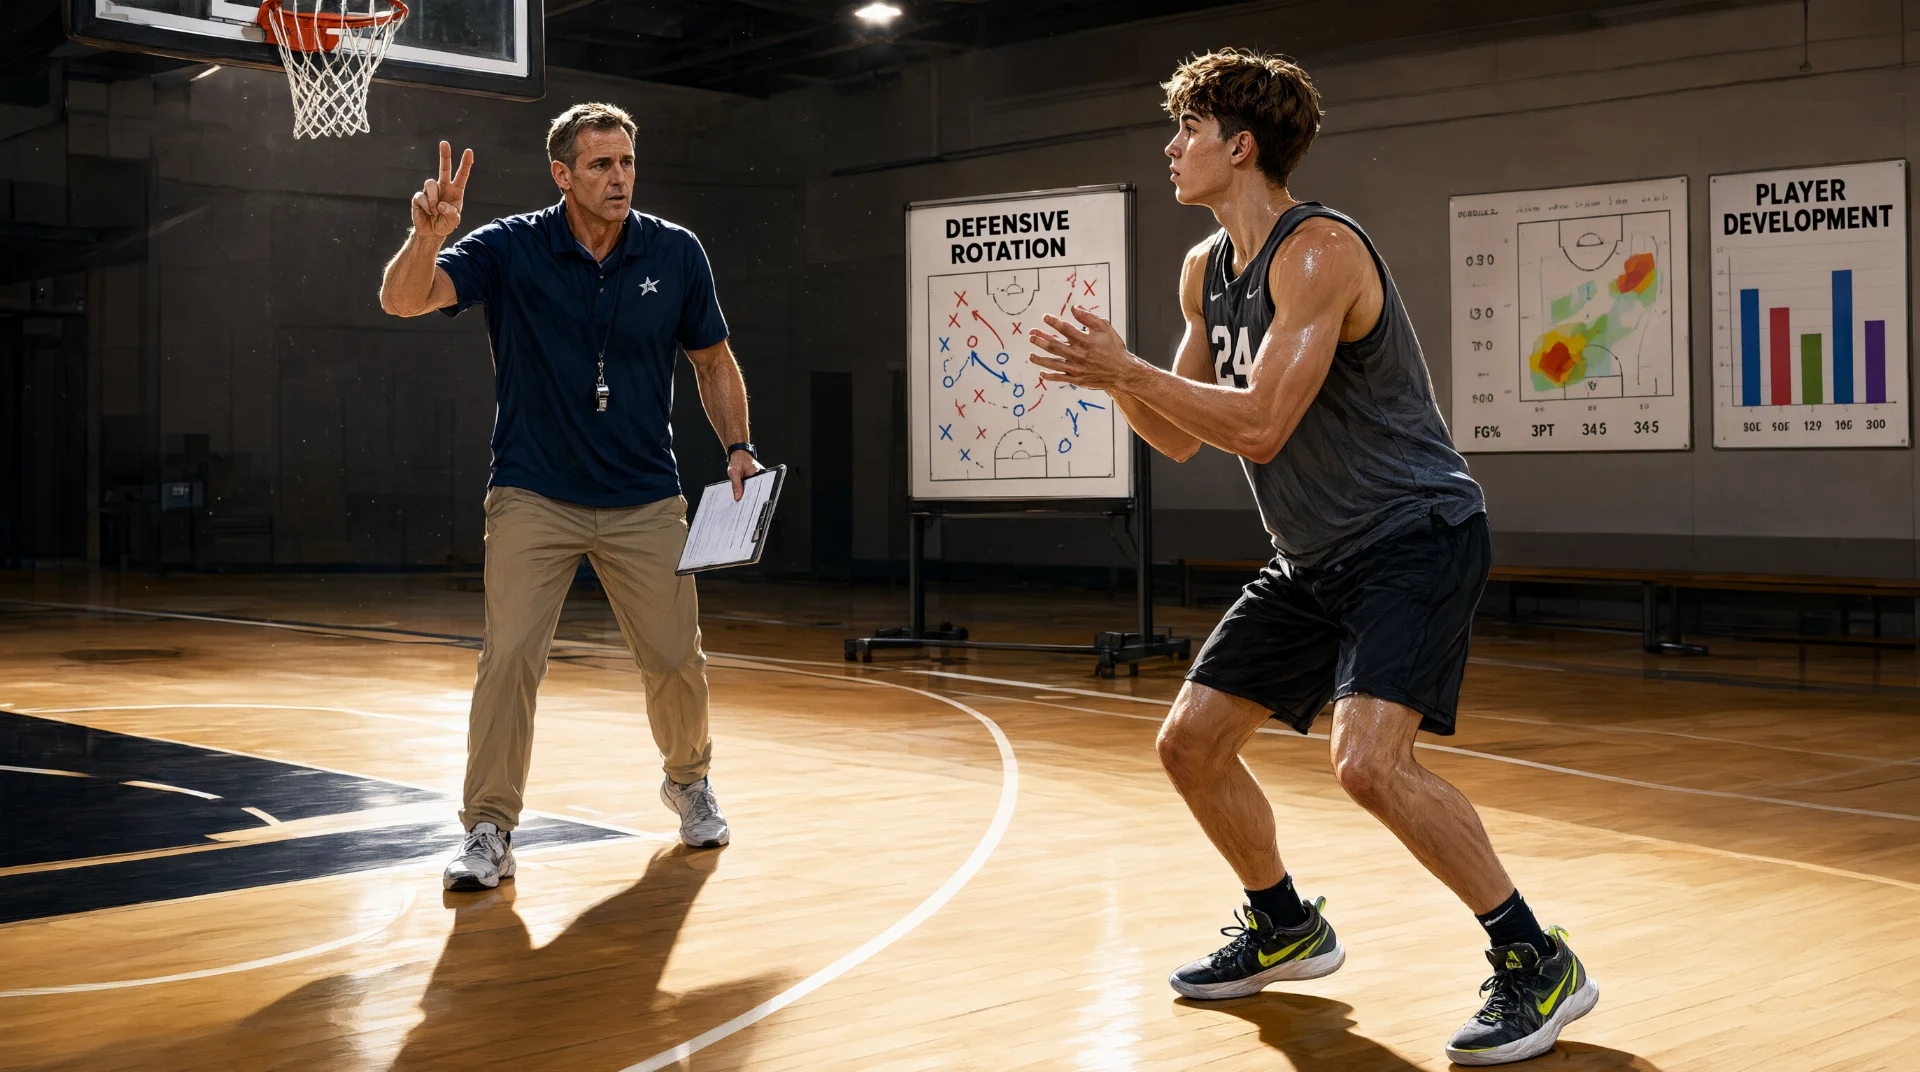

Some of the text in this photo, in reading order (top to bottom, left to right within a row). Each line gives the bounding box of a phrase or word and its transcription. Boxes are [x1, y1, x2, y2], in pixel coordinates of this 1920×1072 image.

[1756, 179, 1846, 206] PLAYER
[946, 210, 1070, 239] DEFENSIVE
[1723, 204, 1893, 235] DEVELOPMENT
[951, 237, 1066, 264] ROTATION
[1212, 325, 1253, 387] 24
[1474, 421, 1659, 439] FG% 3PT 345 345
[1866, 419, 1886, 430] 300
